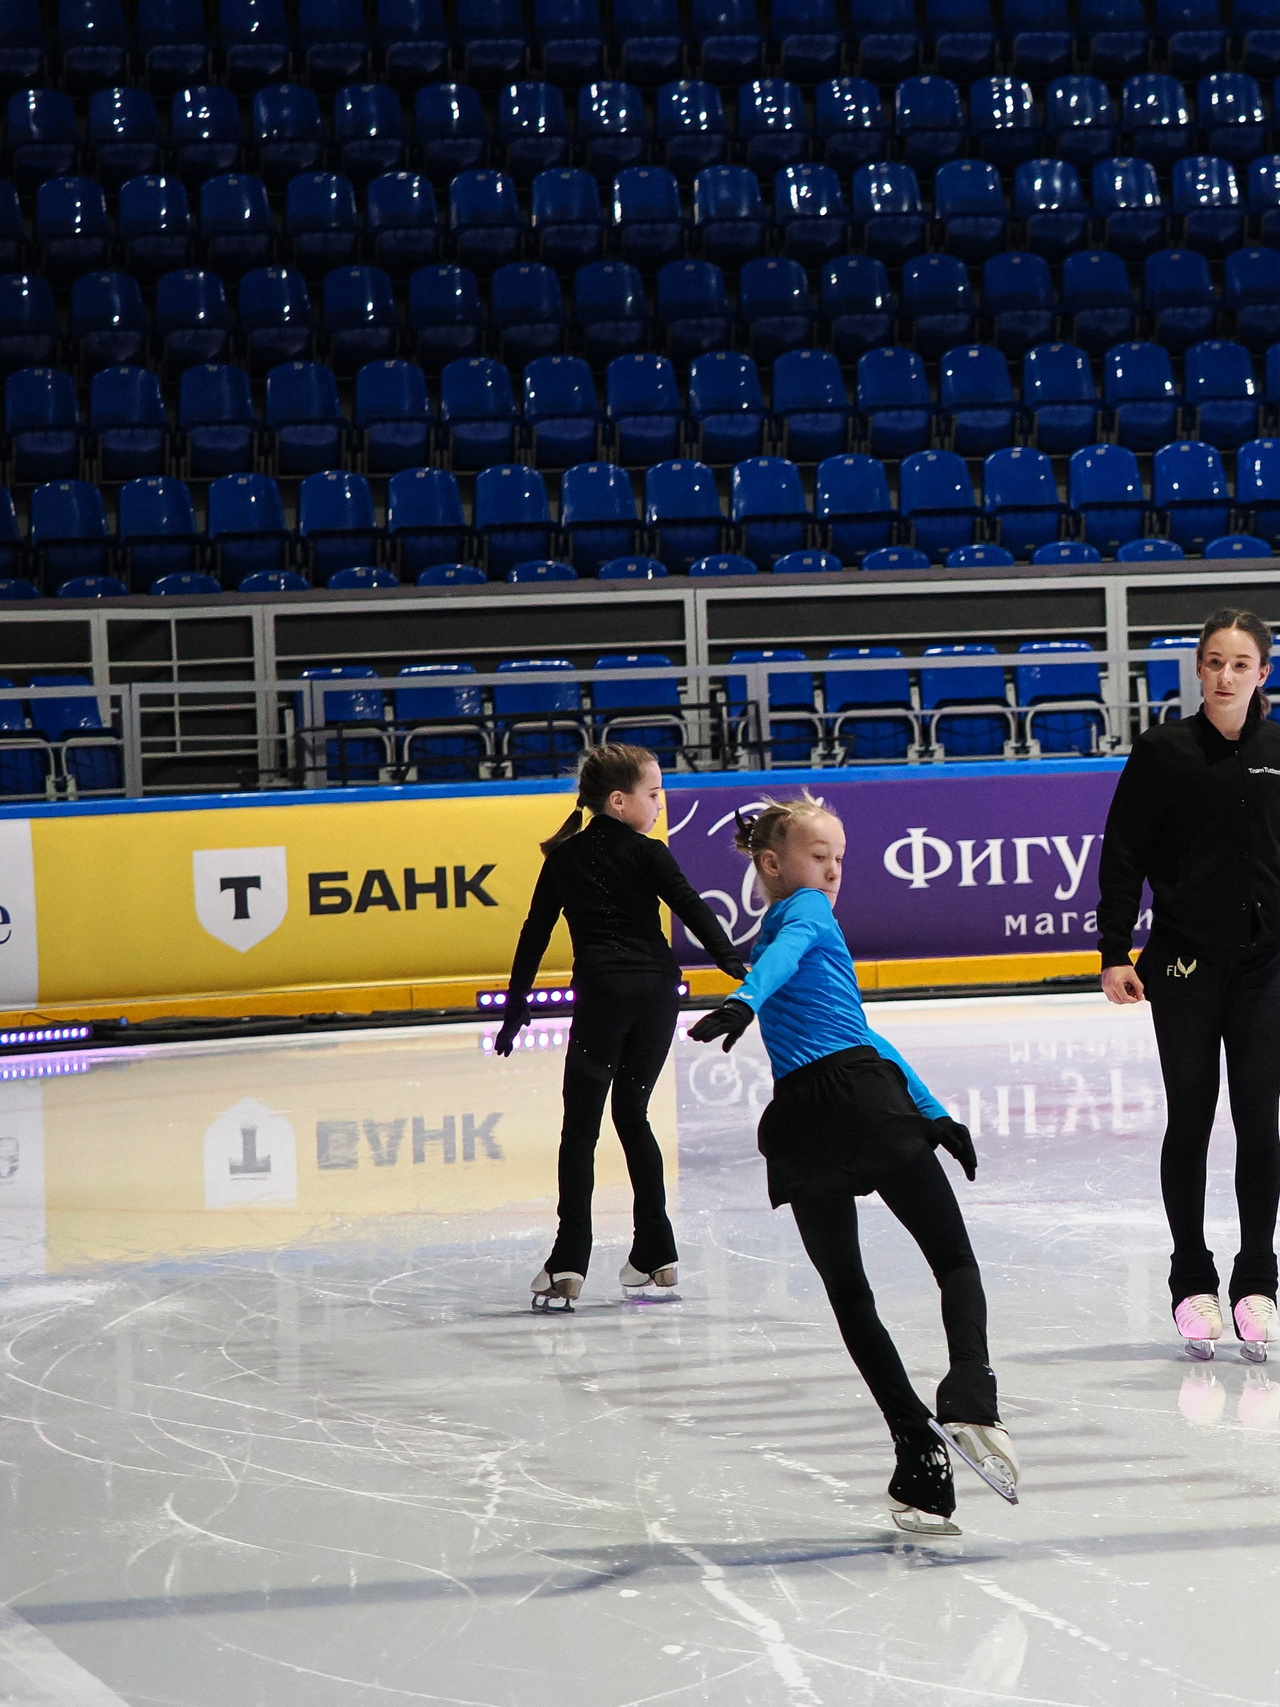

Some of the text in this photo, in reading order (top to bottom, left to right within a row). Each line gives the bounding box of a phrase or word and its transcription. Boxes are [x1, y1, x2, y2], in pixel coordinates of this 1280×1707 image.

[308, 864, 499, 916] БАНК
[883, 827, 1104, 901] Фигу
[1004, 908, 1154, 937] магаи
